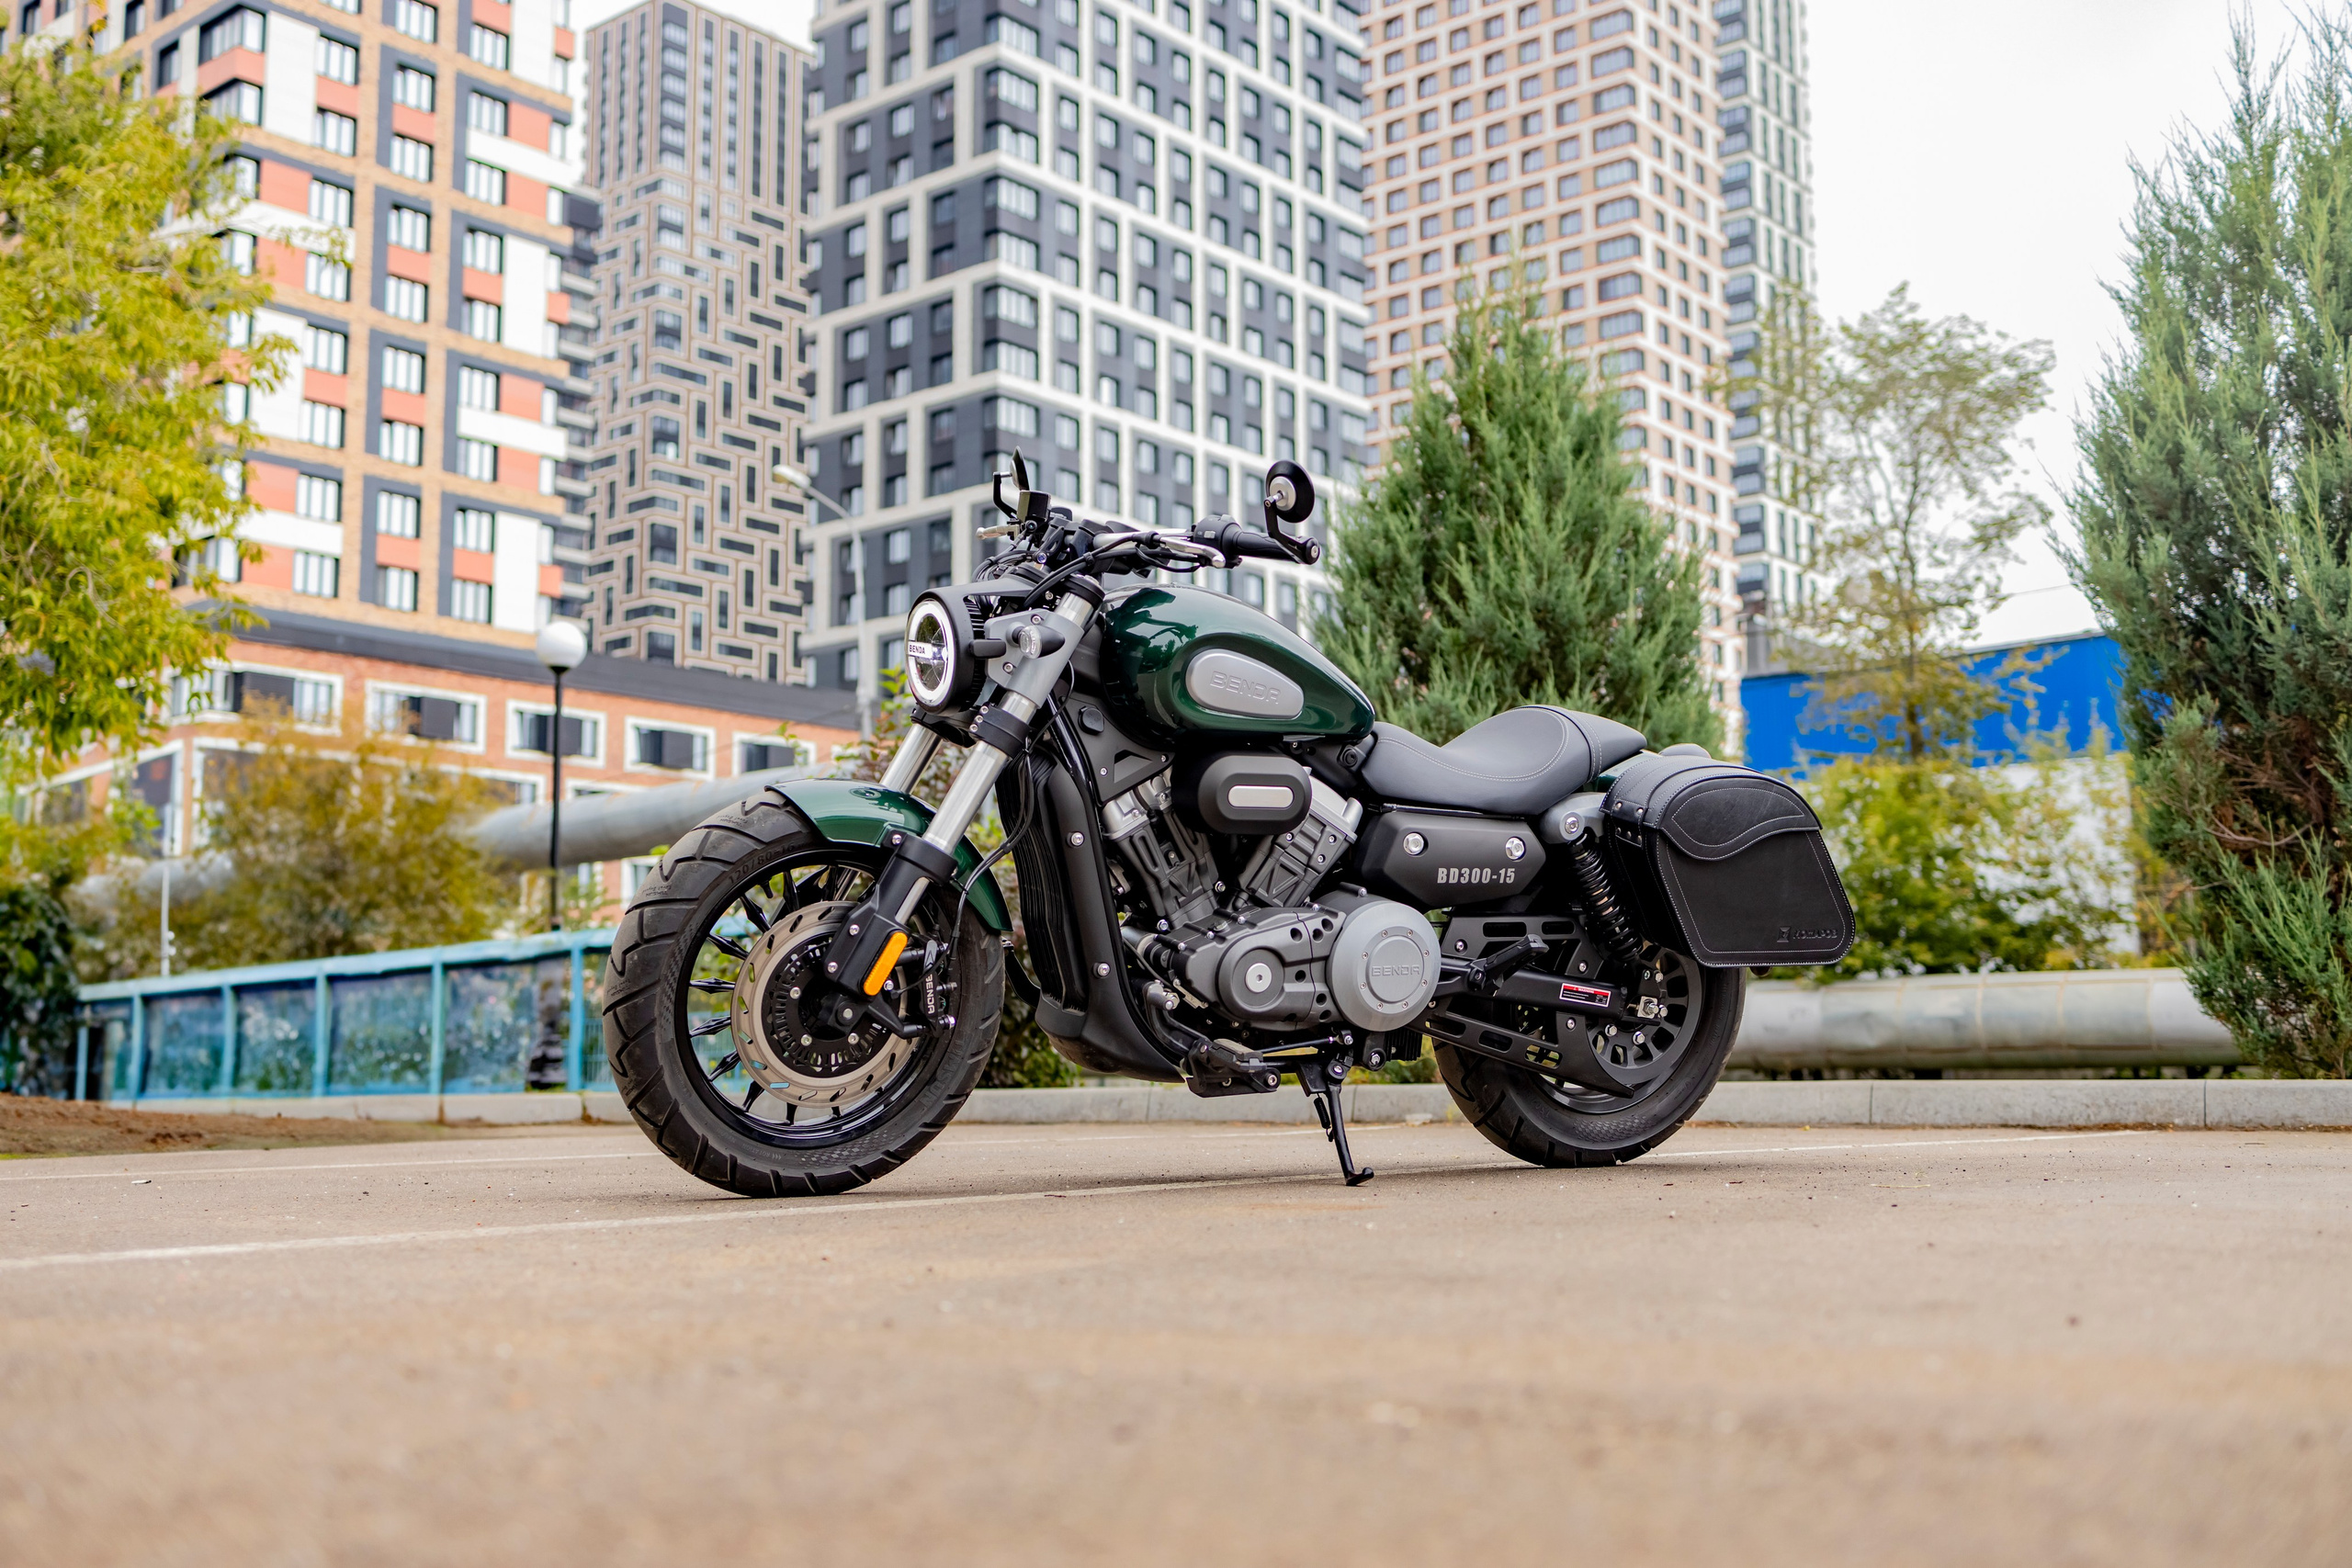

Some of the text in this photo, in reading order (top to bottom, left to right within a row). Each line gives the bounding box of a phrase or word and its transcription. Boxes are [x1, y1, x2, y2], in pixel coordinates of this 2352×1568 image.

[909, 644, 926, 655] BENDA
[1210, 671, 1282, 705] BENDA
[1437, 867, 1516, 884] BD300-15
[1371, 964, 1420, 977] BENDA
